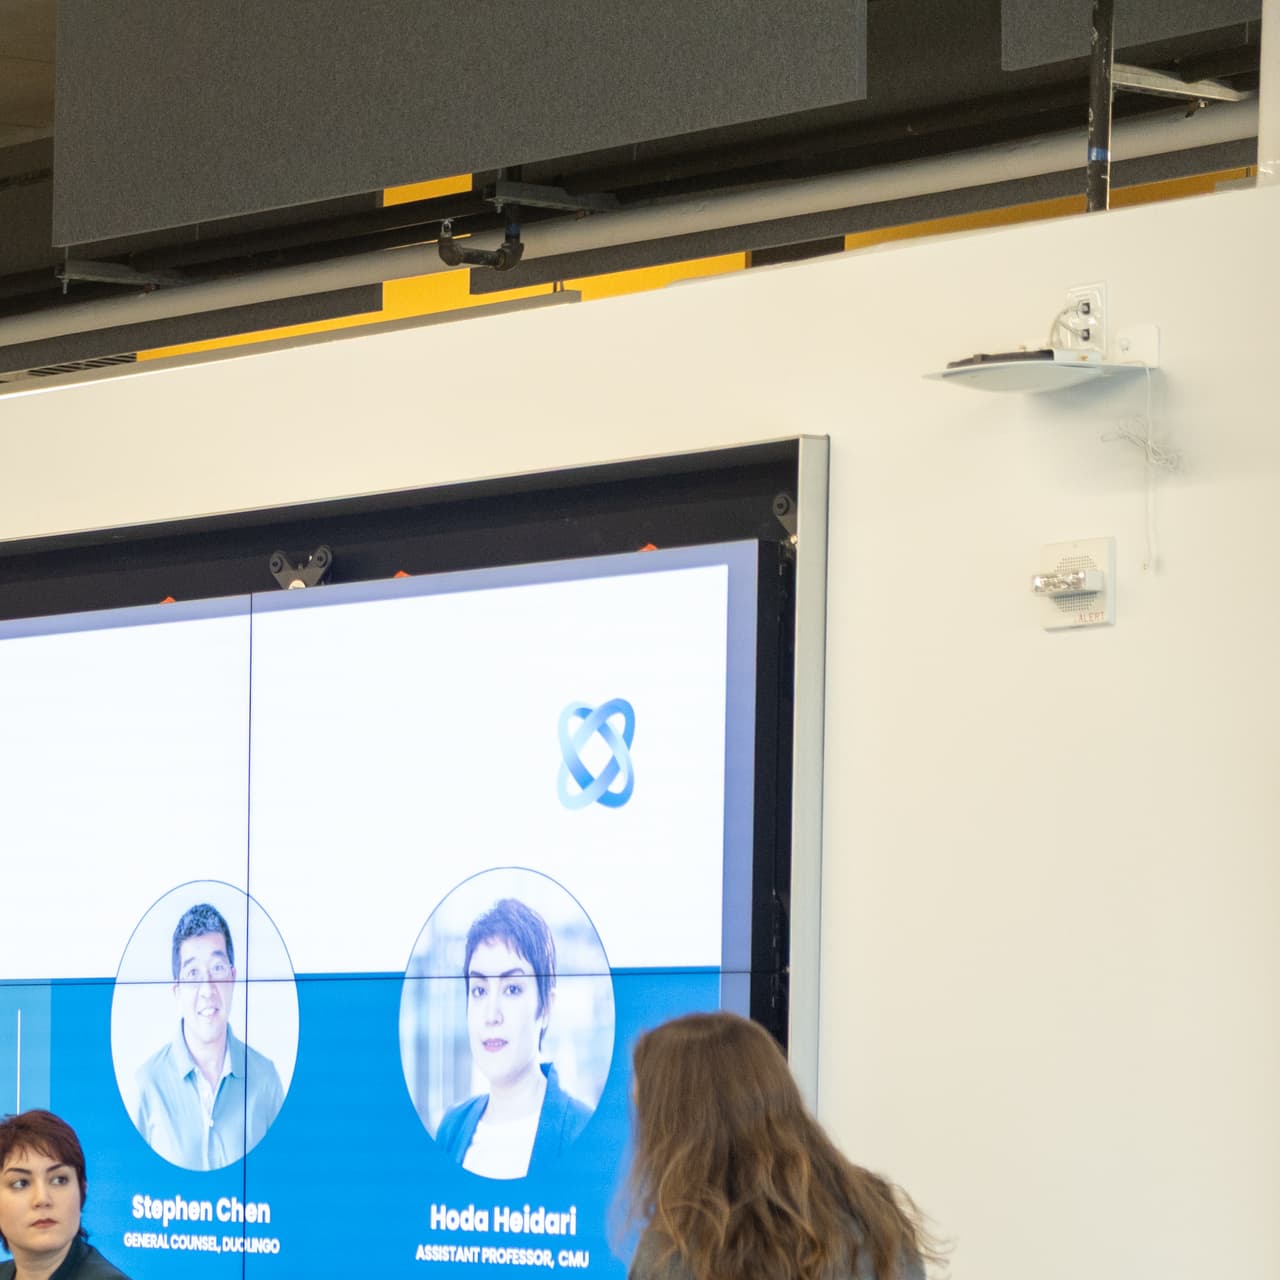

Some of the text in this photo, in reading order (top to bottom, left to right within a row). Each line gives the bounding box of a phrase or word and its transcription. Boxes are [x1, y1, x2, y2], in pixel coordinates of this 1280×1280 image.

[131, 1193, 271, 1227] Stephen Chen
[429, 1203, 577, 1236] Hoda Heidari
[123, 1232, 281, 1254] GENERAL COUNSEL, DUOLINGO
[415, 1244, 590, 1269] ASSISTANT PROFESSOR, CMU
